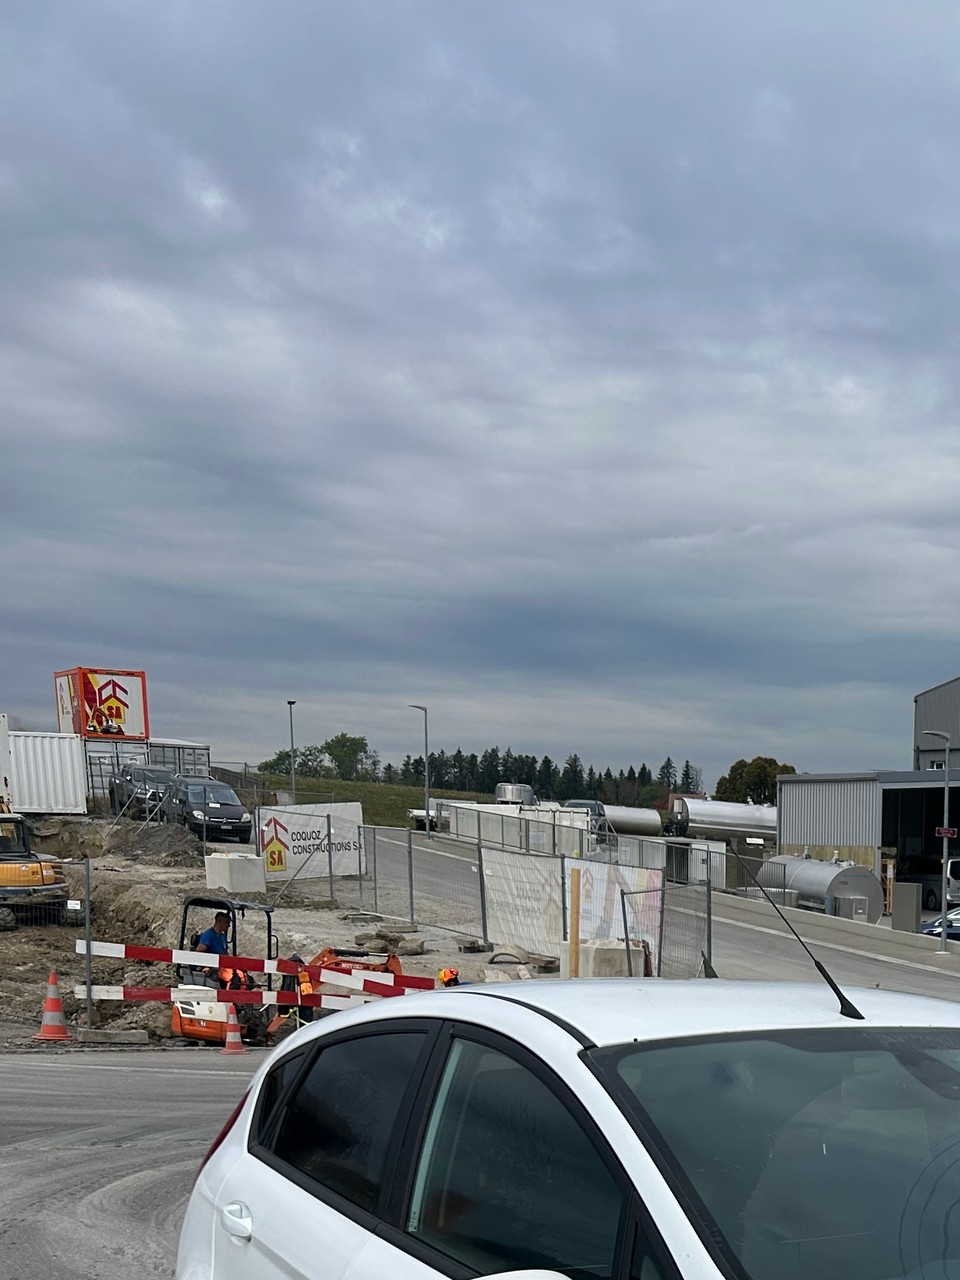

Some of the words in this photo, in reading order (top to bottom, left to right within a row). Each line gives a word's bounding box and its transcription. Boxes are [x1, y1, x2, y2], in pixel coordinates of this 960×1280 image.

[106, 705, 123, 720] SA
[291, 830, 322, 842] COQUOZ
[269, 850, 284, 867] SA
